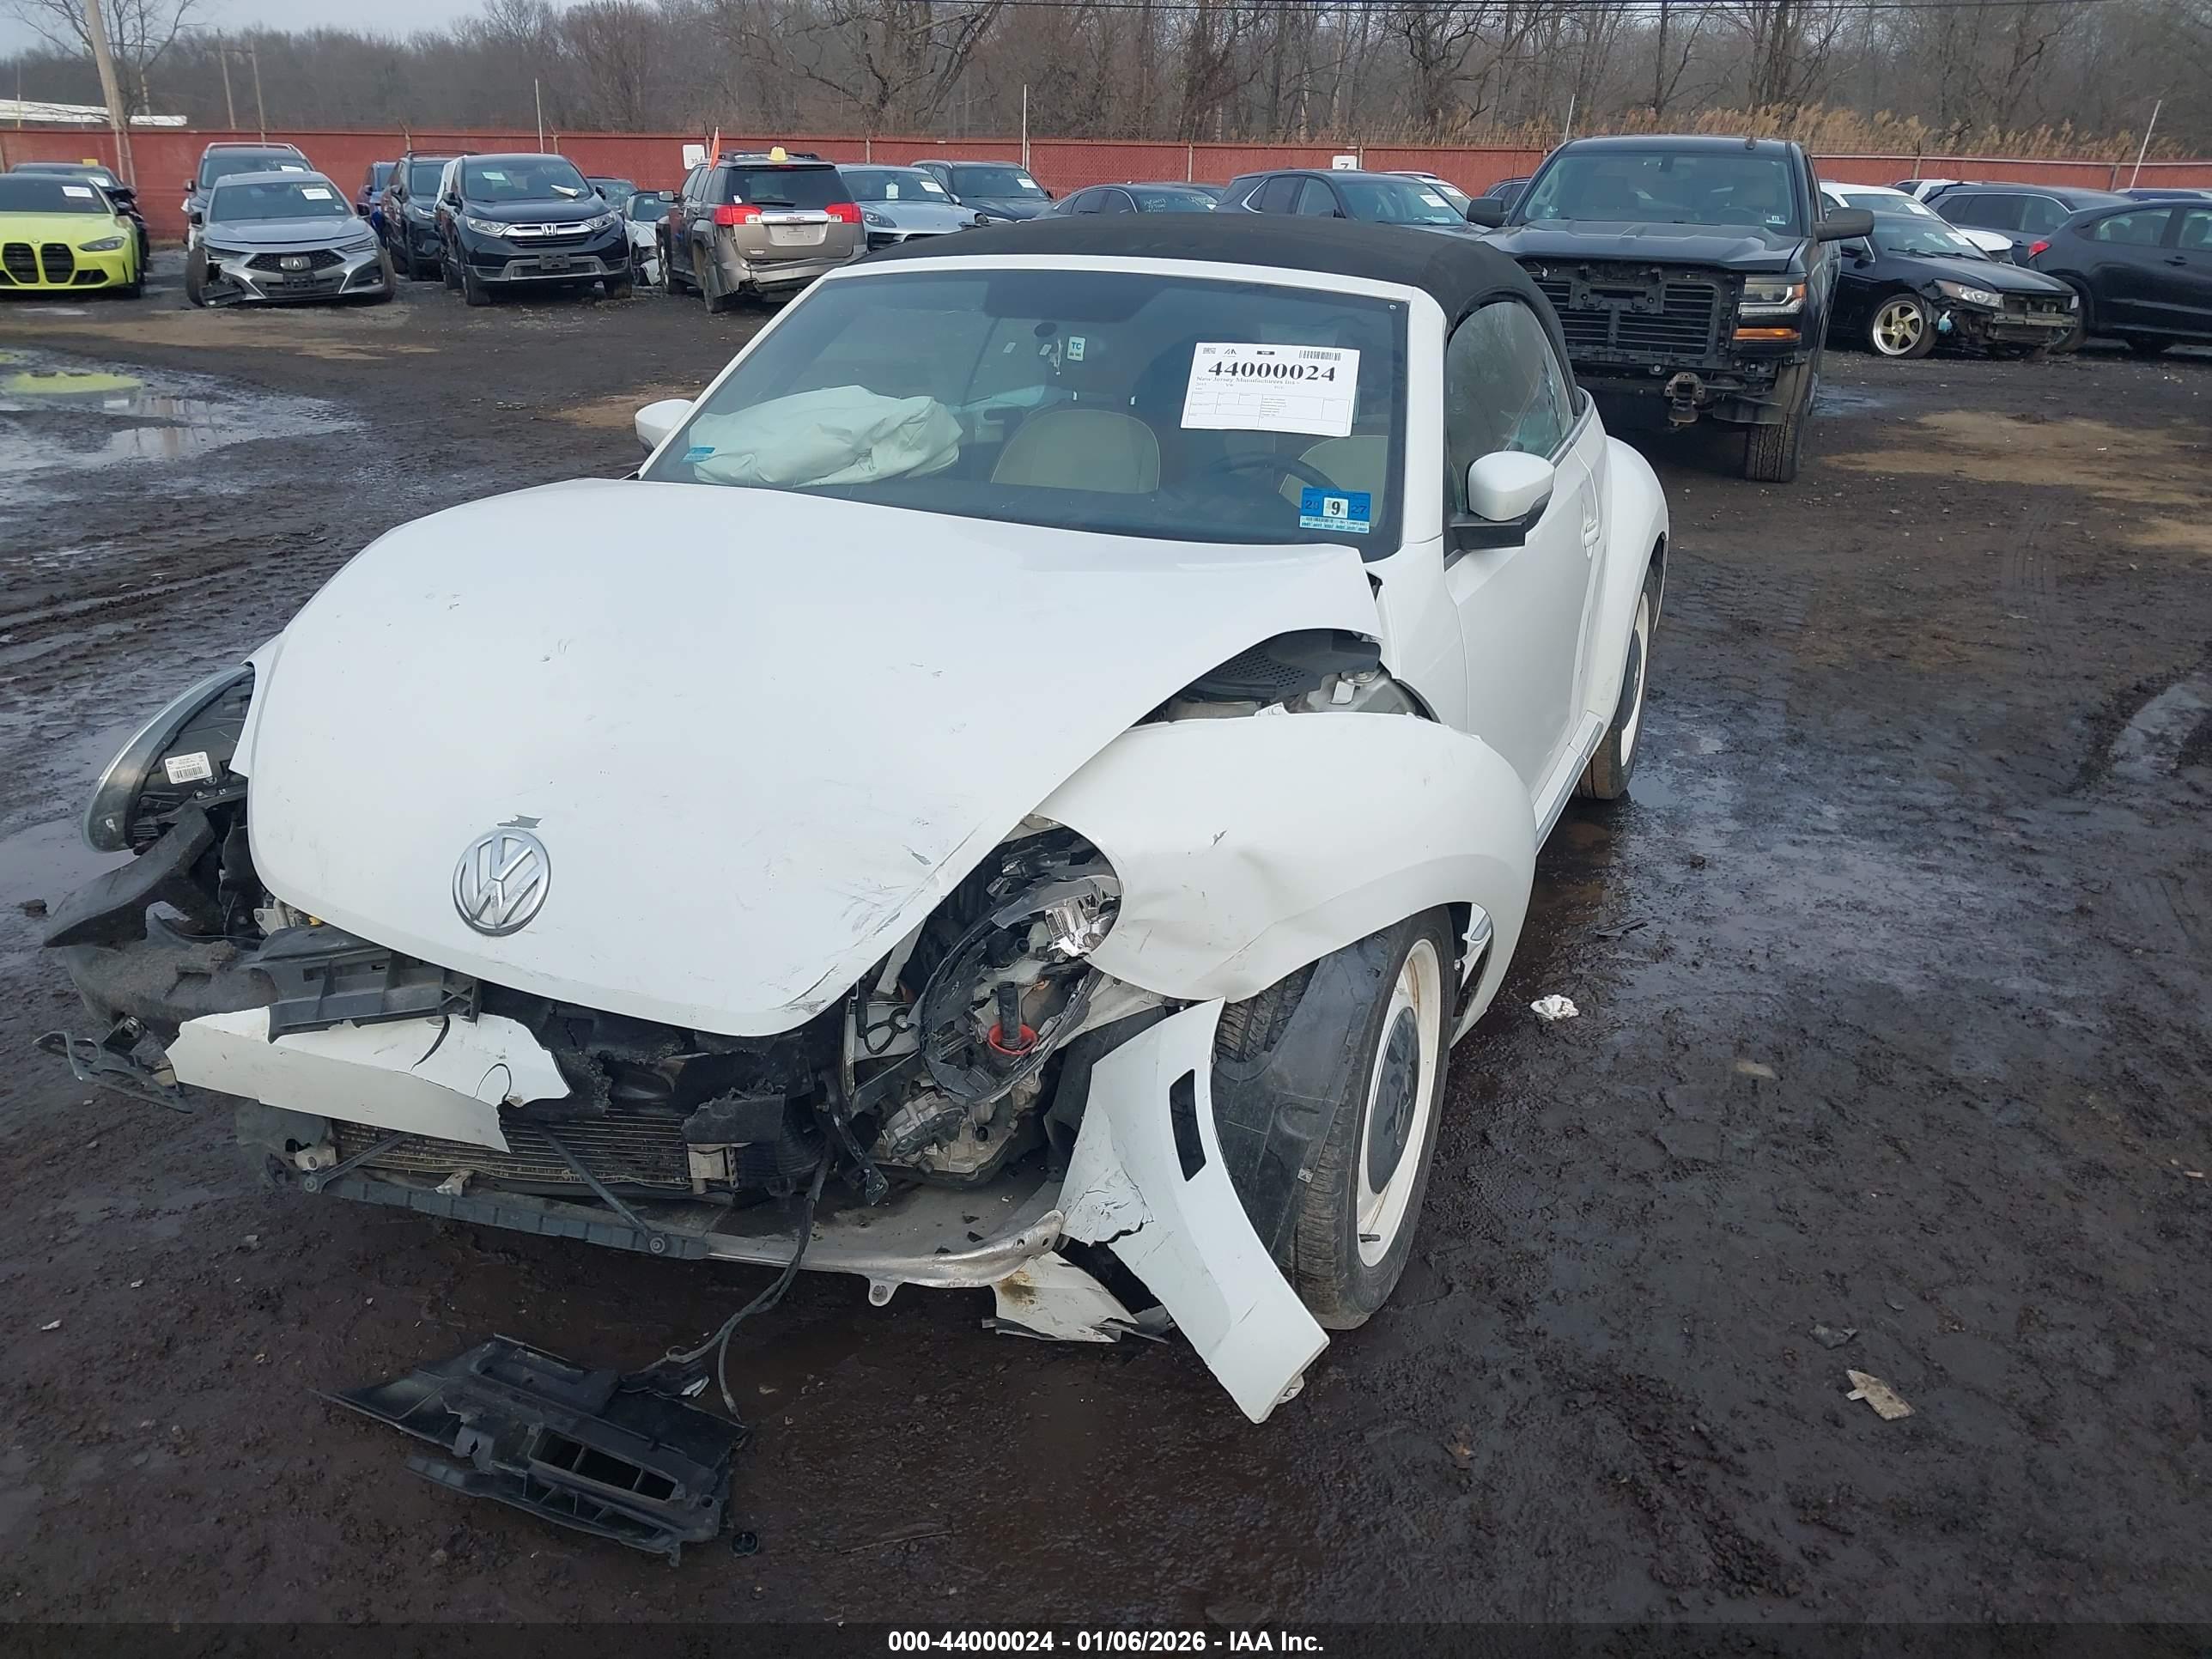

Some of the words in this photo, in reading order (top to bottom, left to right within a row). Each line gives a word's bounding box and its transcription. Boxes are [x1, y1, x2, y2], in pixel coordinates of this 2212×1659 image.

[1071, 341, 1082, 350] TC
[1208, 361, 1335, 382] 44000024
[1331, 501, 1340, 515] 9
[1351, 505, 1367, 514] 27
